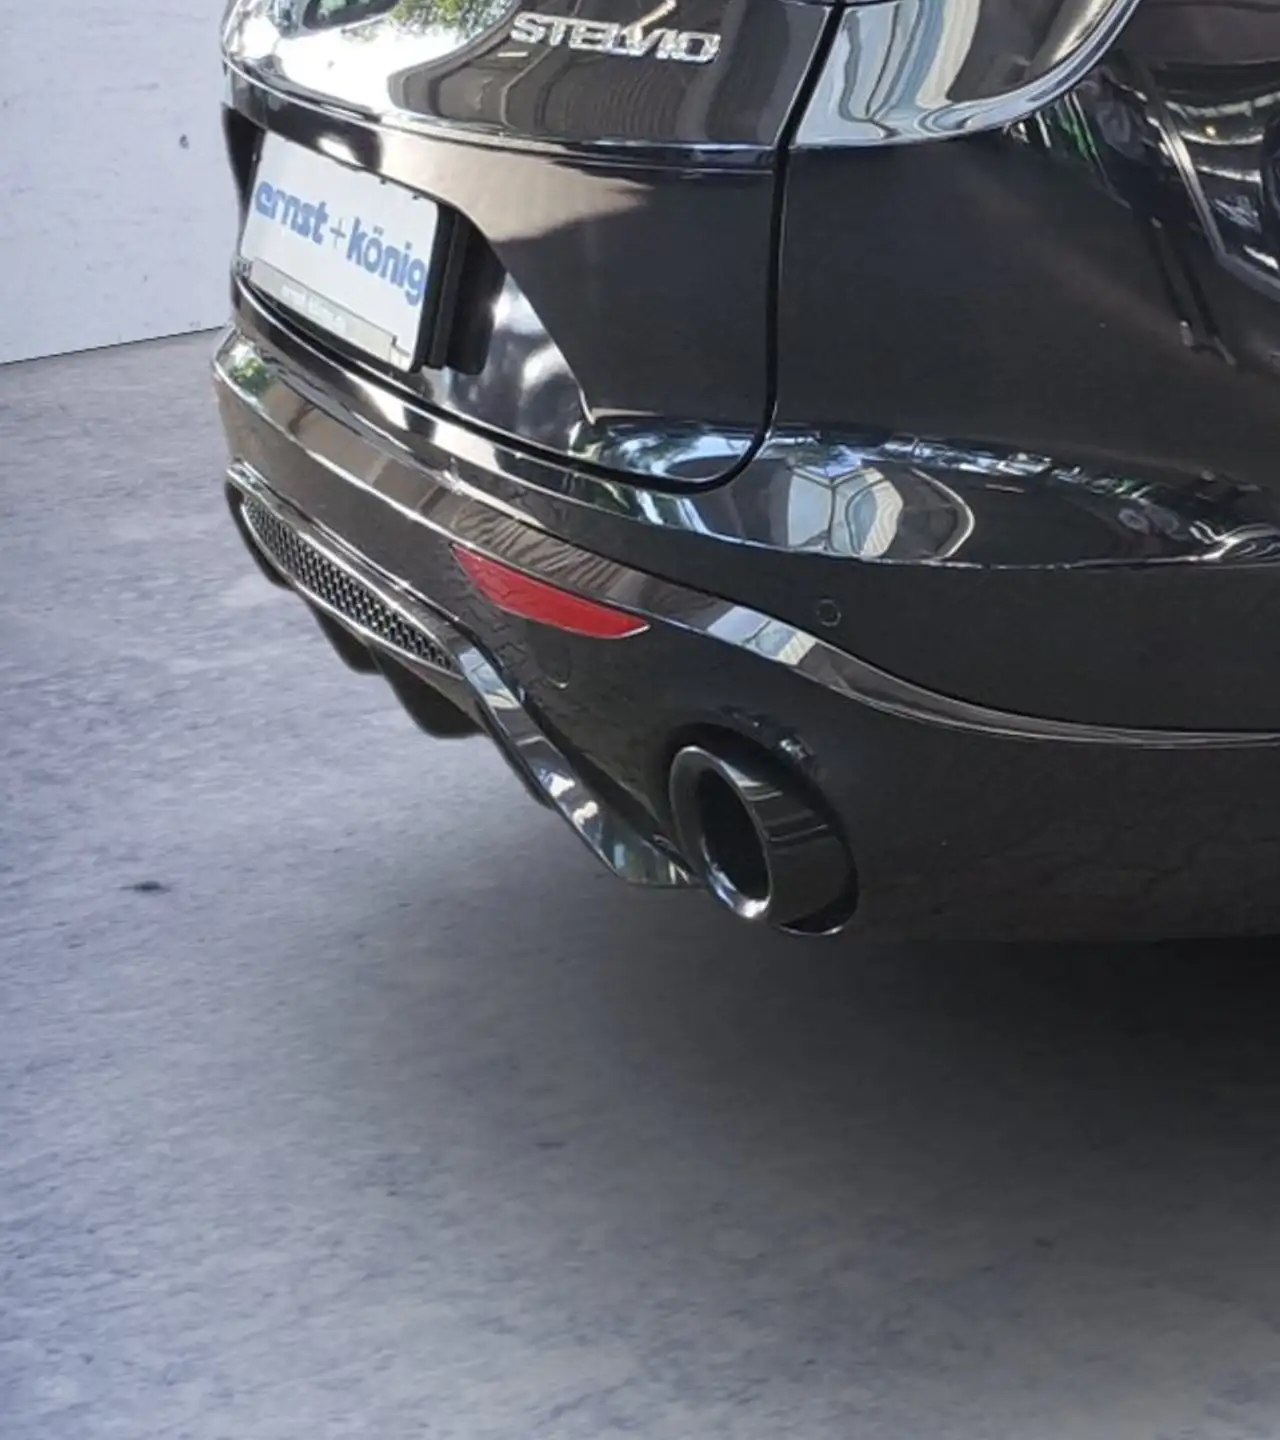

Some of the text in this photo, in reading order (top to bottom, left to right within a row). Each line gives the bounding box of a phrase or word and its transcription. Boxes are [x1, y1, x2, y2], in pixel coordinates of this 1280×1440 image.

[510, 11, 722, 64] STELVIO
[254, 180, 329, 245] ernst
[346, 216, 426, 307] könig
